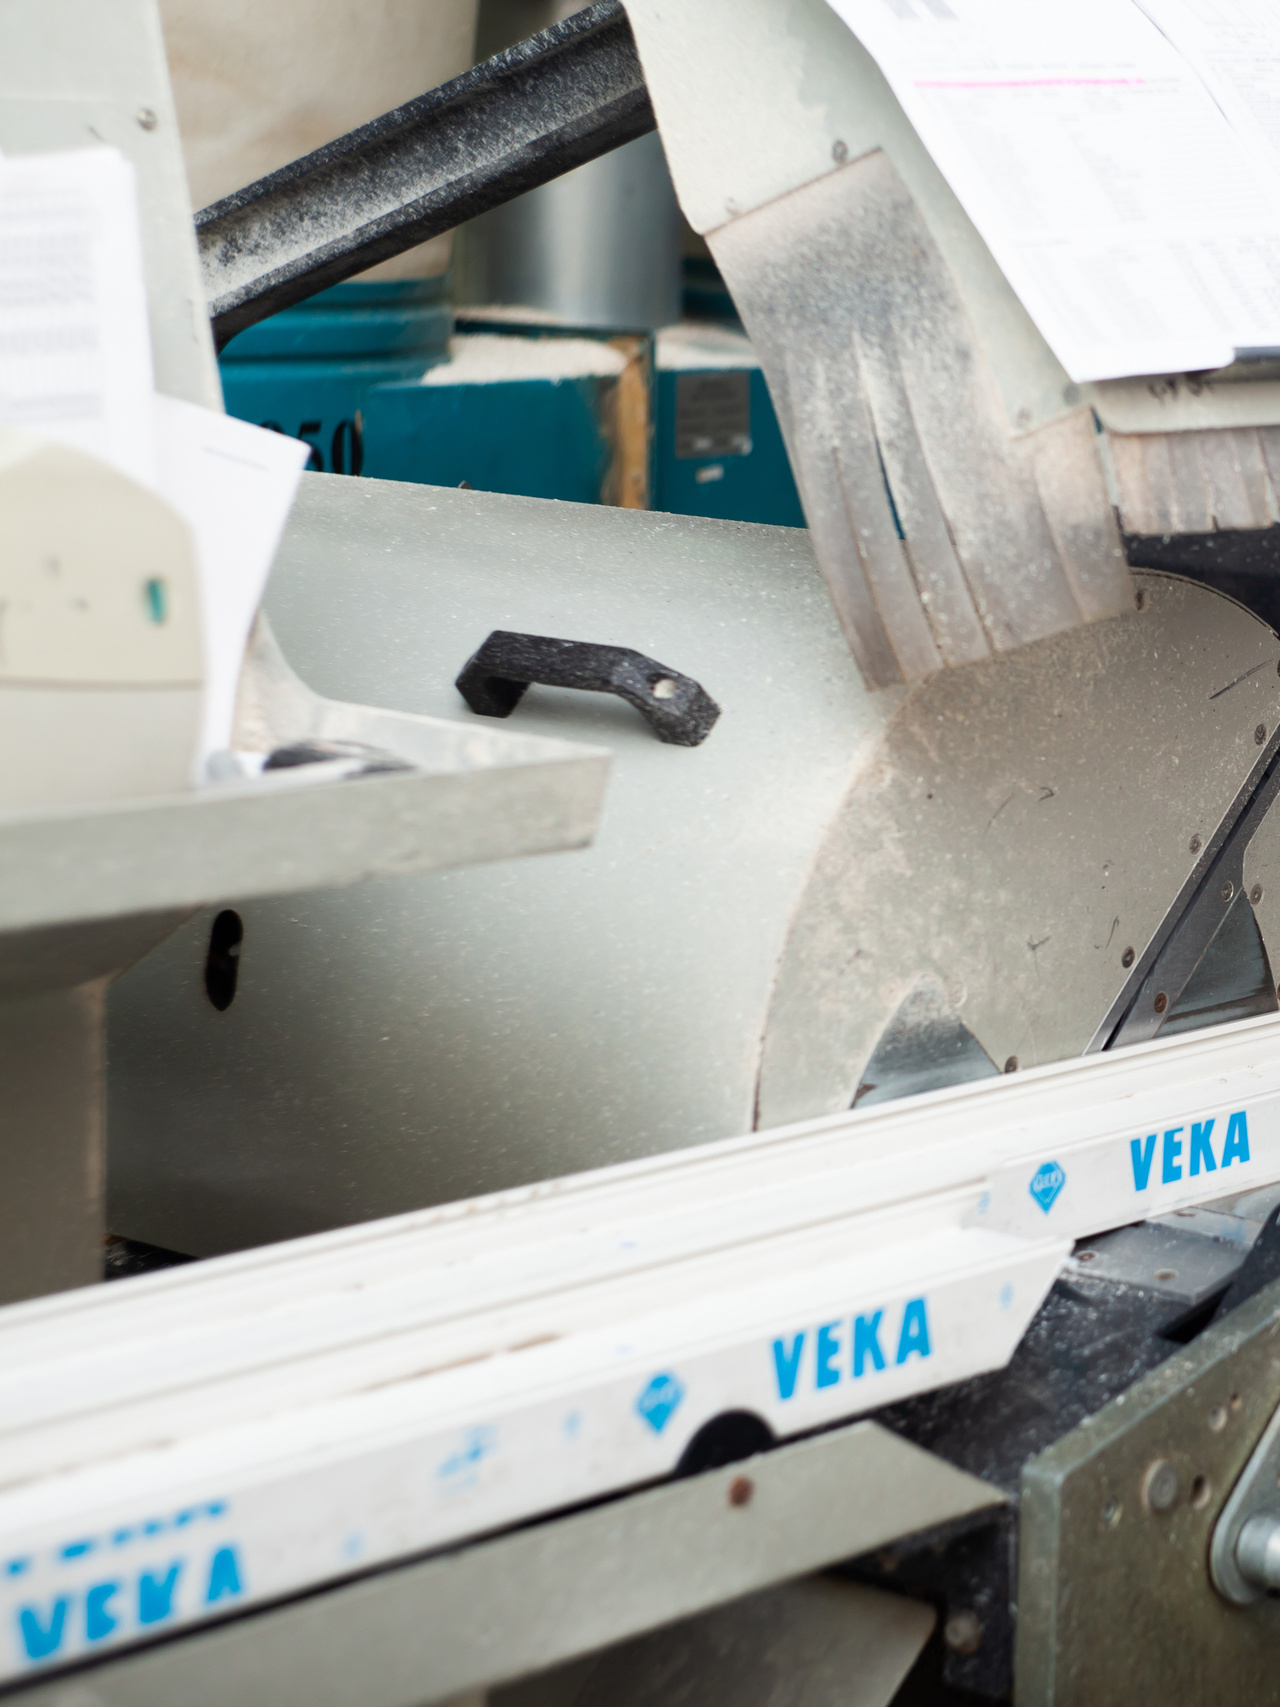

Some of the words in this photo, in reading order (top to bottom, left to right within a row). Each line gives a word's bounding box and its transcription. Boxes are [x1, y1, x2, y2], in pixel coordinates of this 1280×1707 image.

[258, 417, 364, 477] 50
[1130, 1110, 1250, 1192] VEKA
[772, 1296, 932, 1401] VEKA
